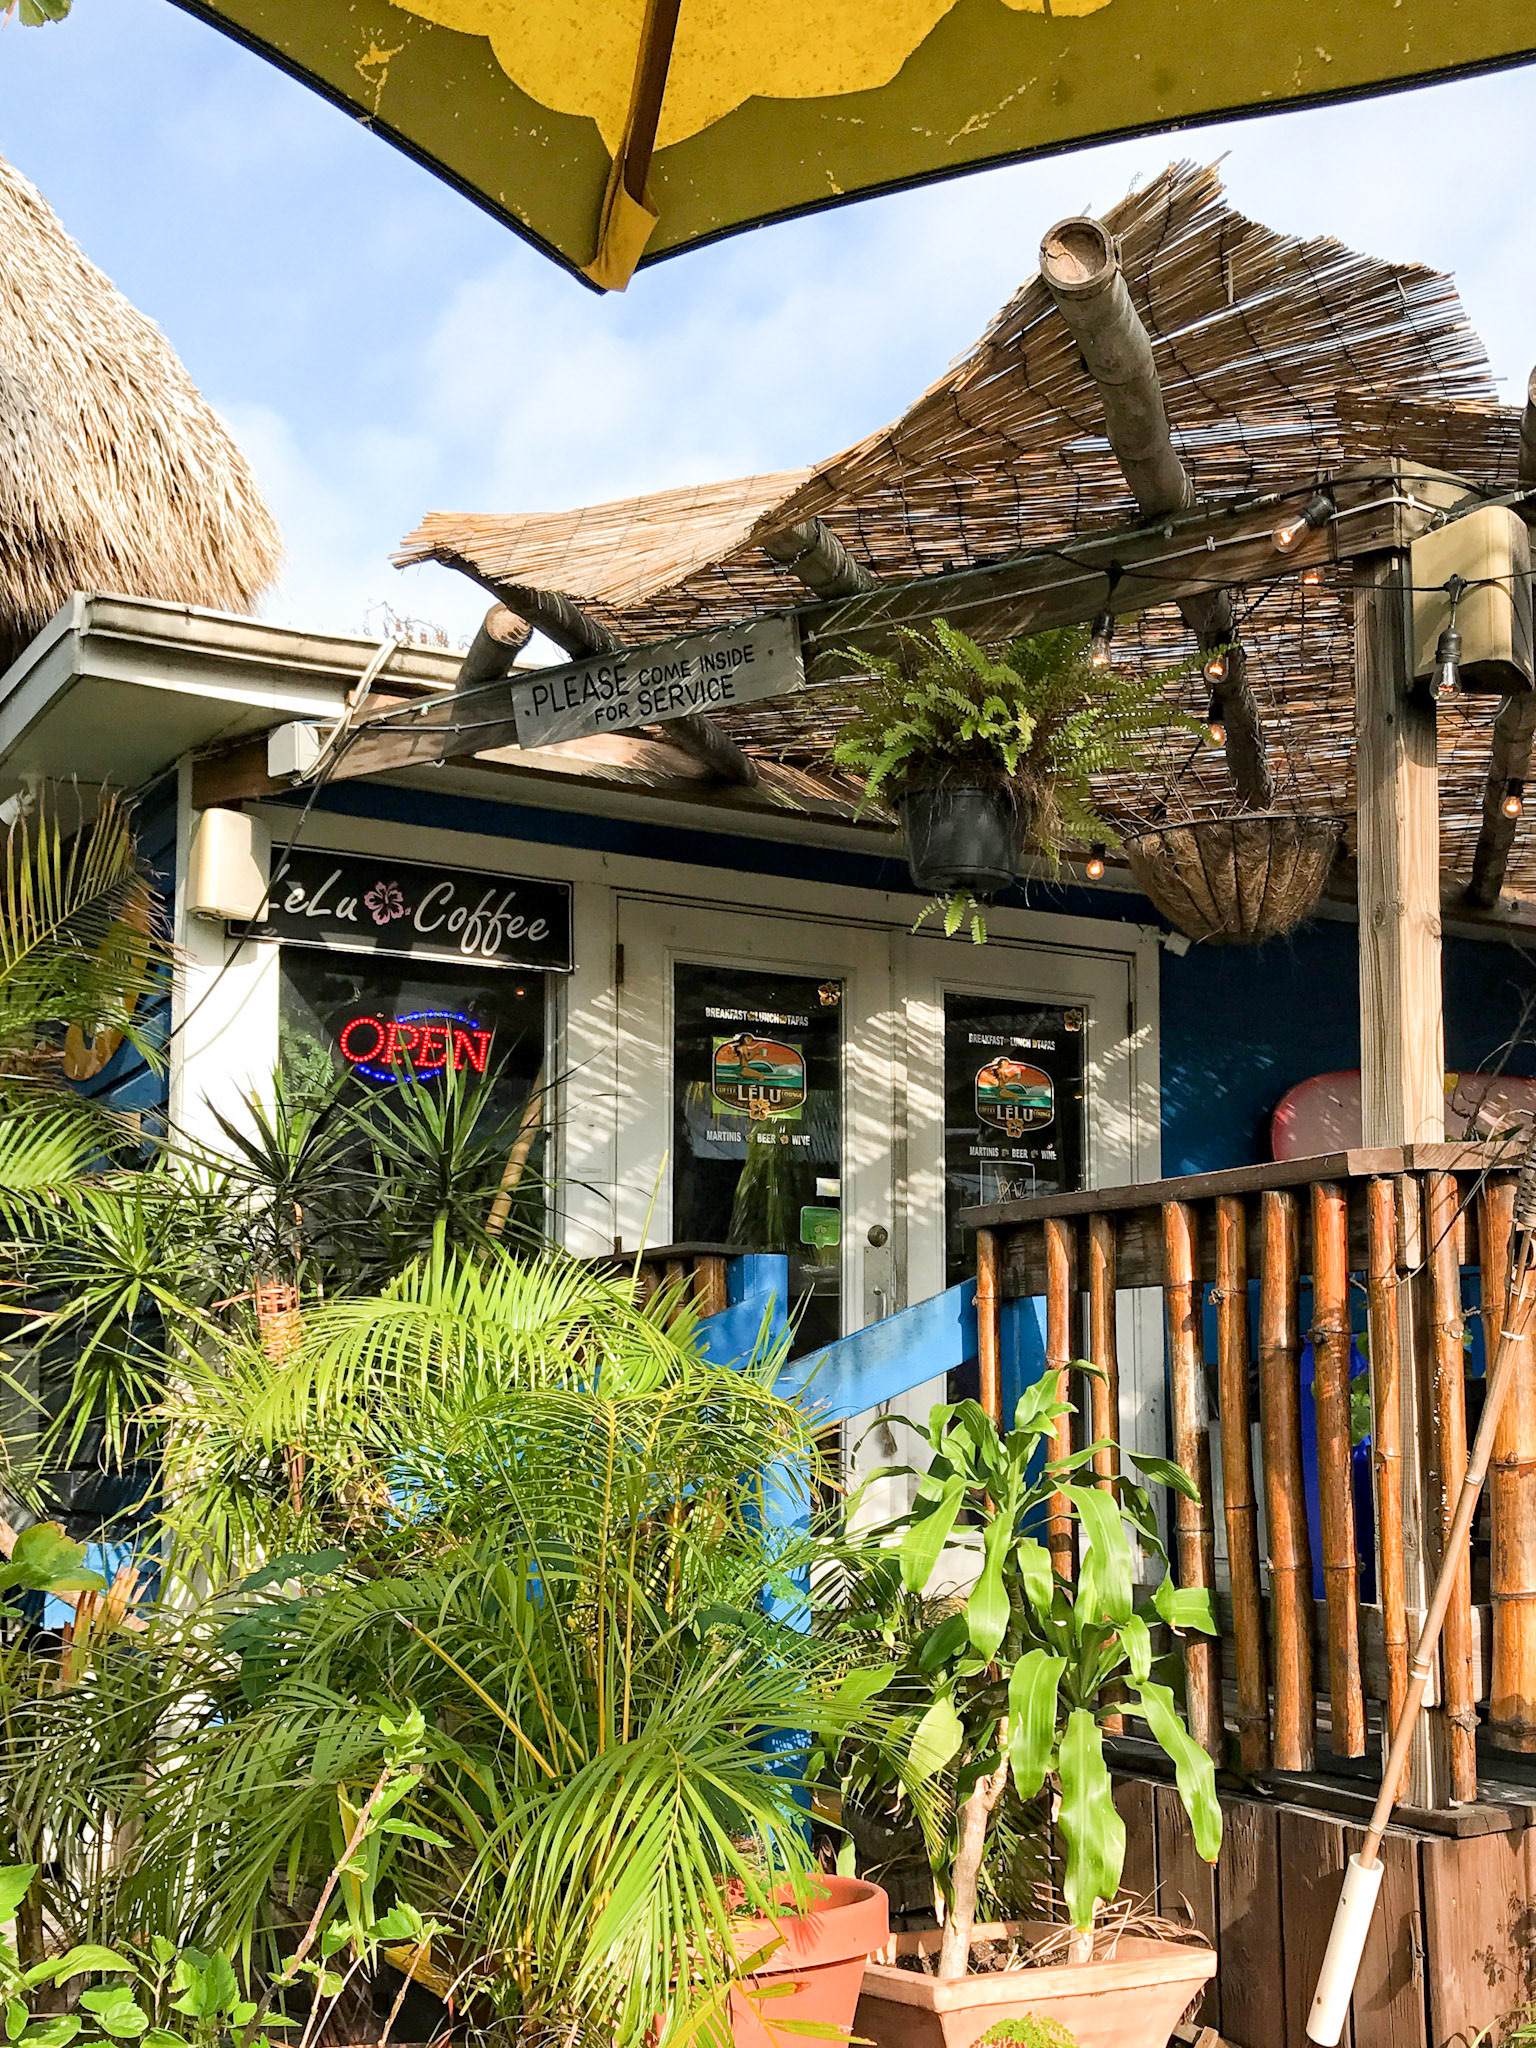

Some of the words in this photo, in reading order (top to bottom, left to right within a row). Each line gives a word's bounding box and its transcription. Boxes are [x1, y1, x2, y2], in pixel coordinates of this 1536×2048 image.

[532, 662, 630, 716] PLEASE
[638, 659, 691, 687] COME
[700, 644, 755, 675] INSIDE
[595, 702, 630, 725] FOR
[638, 673, 736, 716] SERVICE
[413, 881, 550, 957] Coffee
[705, 1006, 748, 1021] BREAKFAST
[755, 1011, 780, 1024] LUNCH
[786, 1014, 809, 1026] TAPAS
[339, 1017, 492, 1073] OPEN
[968, 1032, 1004, 1046] BREAKFAST
[1009, 1036, 1032, 1048] LUNCH
[1037, 1039, 1056, 1051] TAPAS
[706, 1129, 742, 1143] MARTINIS
[756, 1132, 777, 1145] BEER
[791, 1134, 811, 1146] WINE
[968, 1145, 1000, 1157] MARTINIS
[1011, 1147, 1029, 1159] BEER
[1041, 1149, 1058, 1160] WINE
